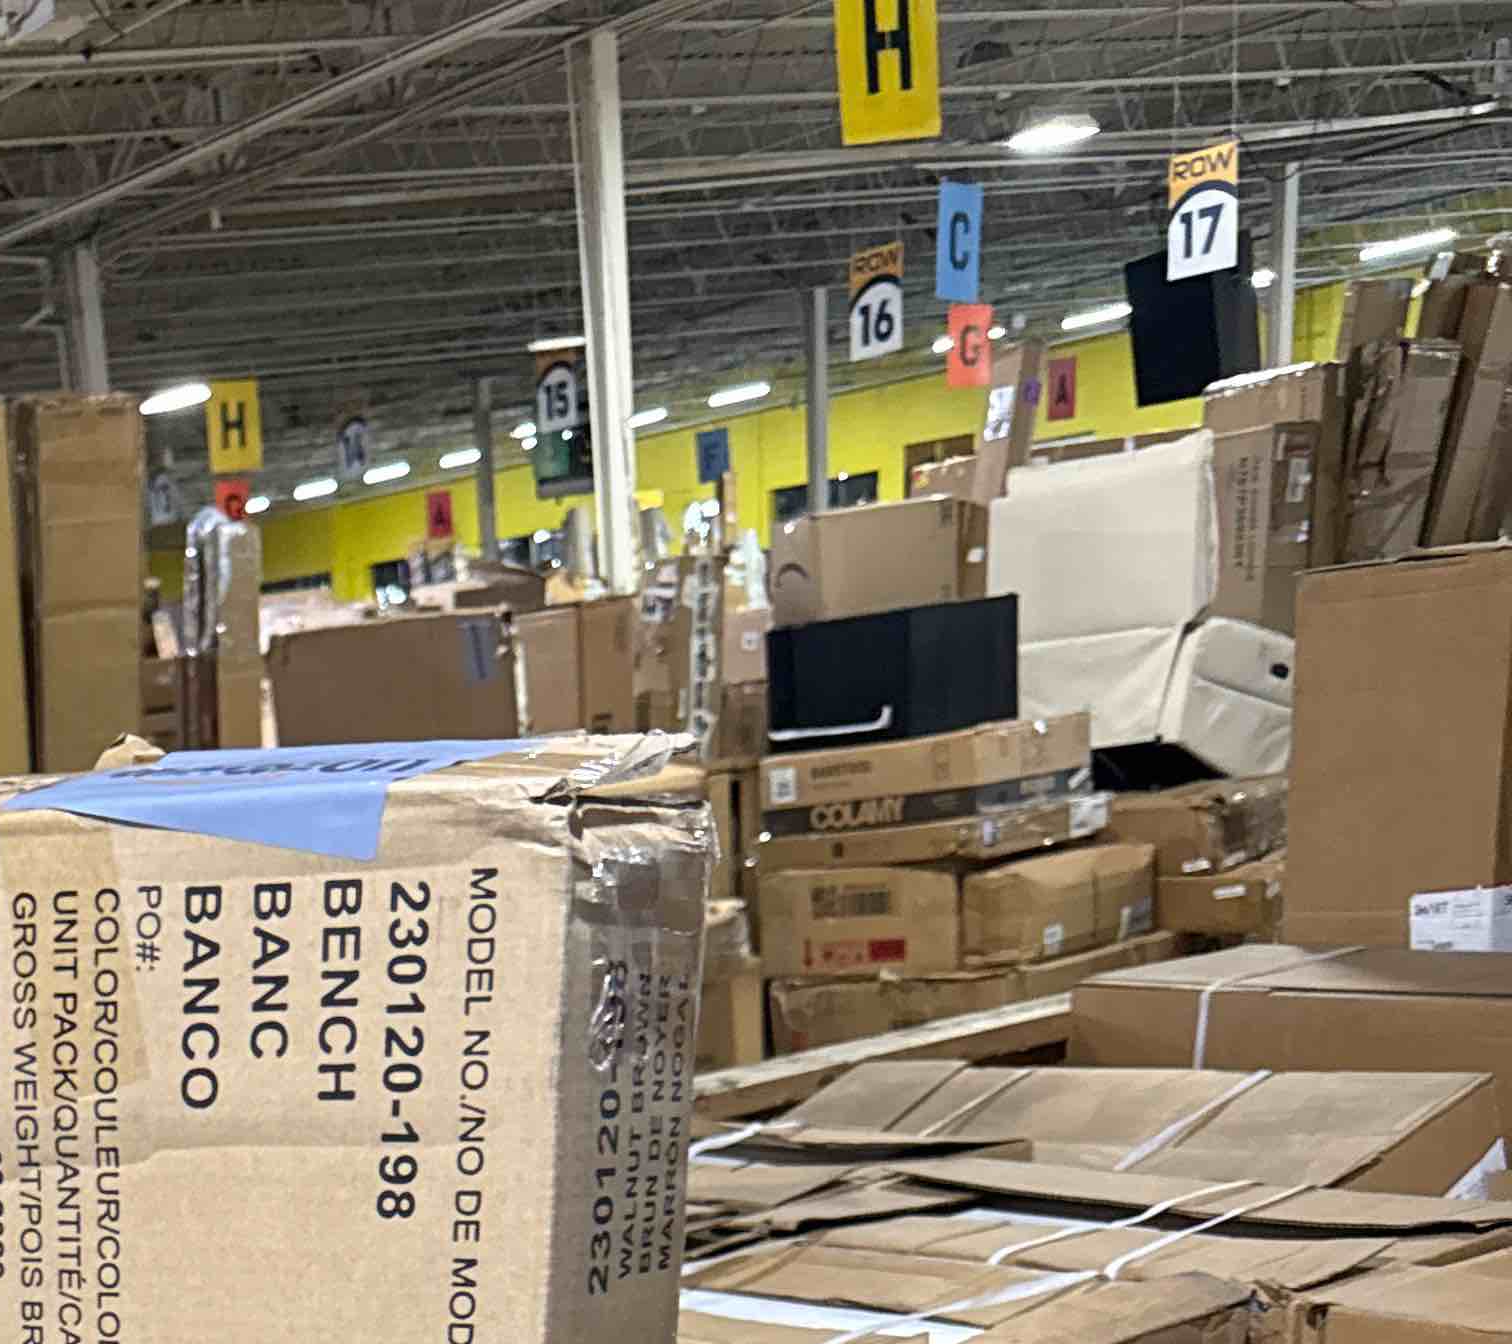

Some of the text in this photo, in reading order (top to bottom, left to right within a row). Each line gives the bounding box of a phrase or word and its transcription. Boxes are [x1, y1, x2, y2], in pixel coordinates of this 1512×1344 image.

[863, 0, 914, 95] H
[1171, 146, 1238, 186] ROW
[852, 242, 901, 277] ROW
[948, 210, 971, 273] C
[1178, 201, 1226, 261] 17
[857, 299, 895, 348] 16
[958, 322, 981, 368] G
[219, 401, 247, 449] H
[544, 381, 570, 421] 15
[809, 799, 905, 830] COLAMY
[12, 892, 39, 1030] GROSS
[52, 890, 79, 982] UNIT
[134, 885, 163, 973] PO#:
[250, 882, 292, 1059] BANC
[464, 867, 498, 1017] MODEL
[181, 885, 223, 1110] BANCO
[318, 878, 363, 1102] BENCH
[376, 880, 431, 1220] 230120-198
[455, 1028, 491, 1176] NO./NO
[618, 972, 652, 1279] WALNUT BROWN
[639, 974, 671, 1274] BRUN DE NOYER
[15, 1042, 43, 1289] WEIGHT/POIS
[452, 1188, 483, 1243] DE
